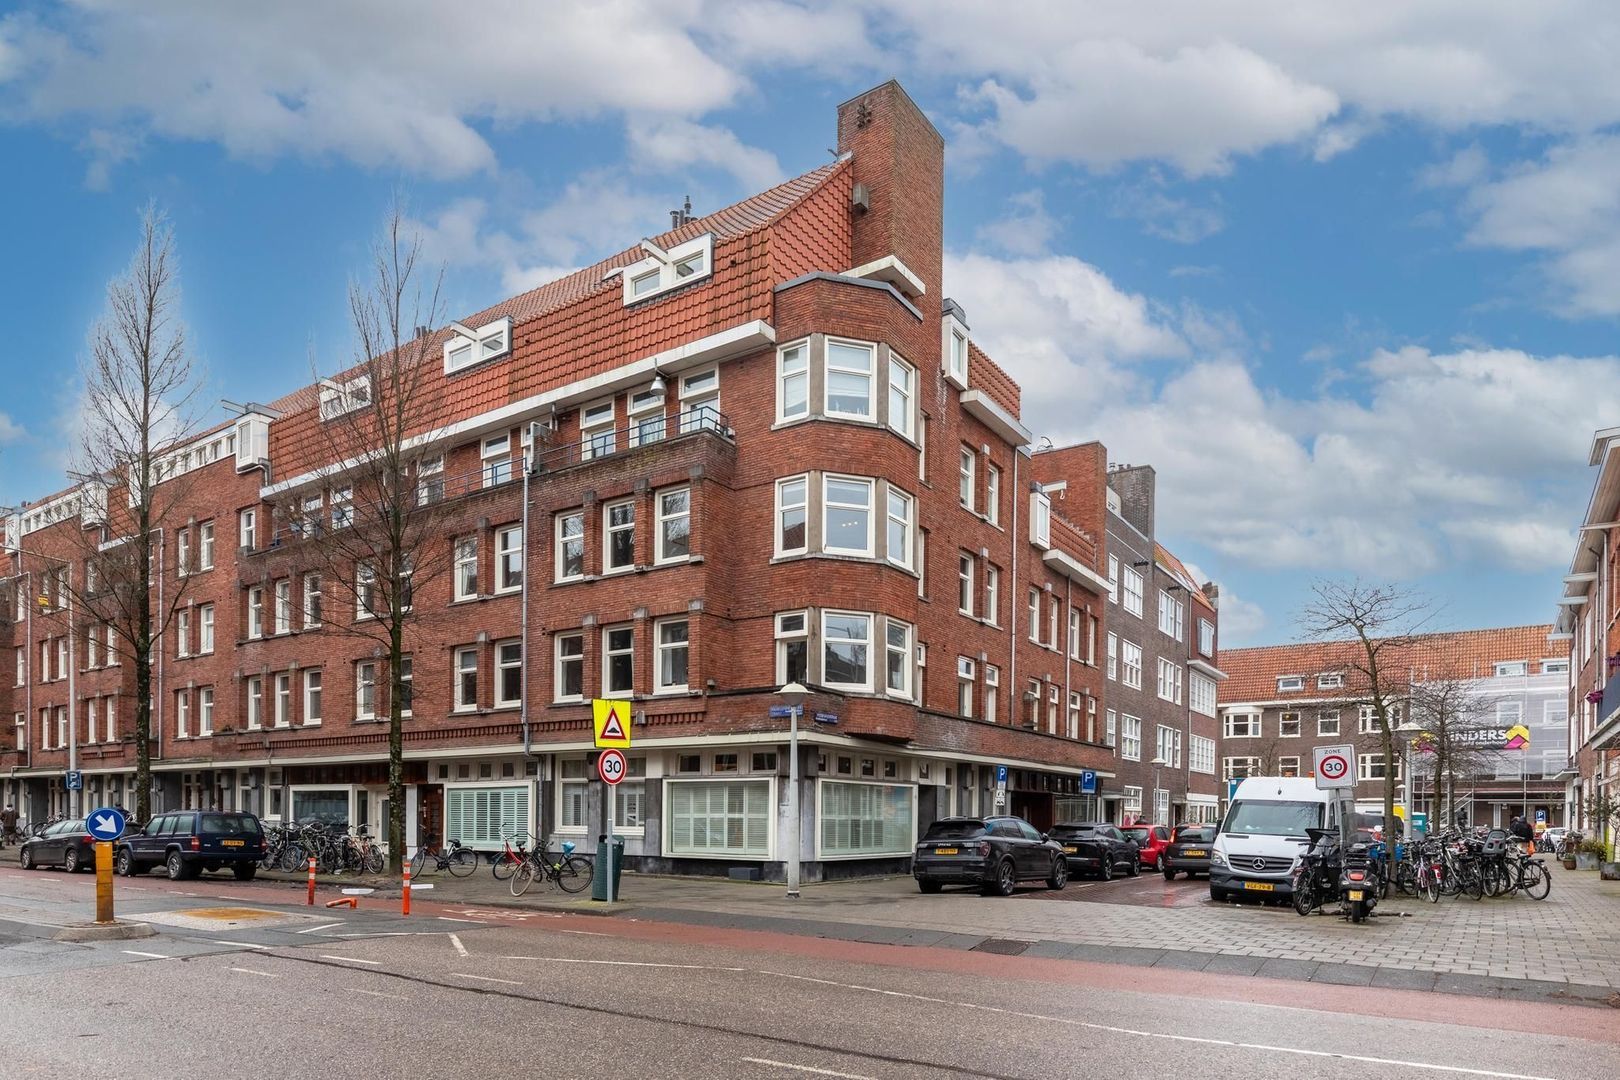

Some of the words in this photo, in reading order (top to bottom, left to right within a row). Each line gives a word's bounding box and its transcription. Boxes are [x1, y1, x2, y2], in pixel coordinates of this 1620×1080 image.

[605, 760, 622, 774] 30
[1325, 762, 1343, 772] 30
[1000, 768, 1006, 779] P
[1085, 772, 1093, 783] P
